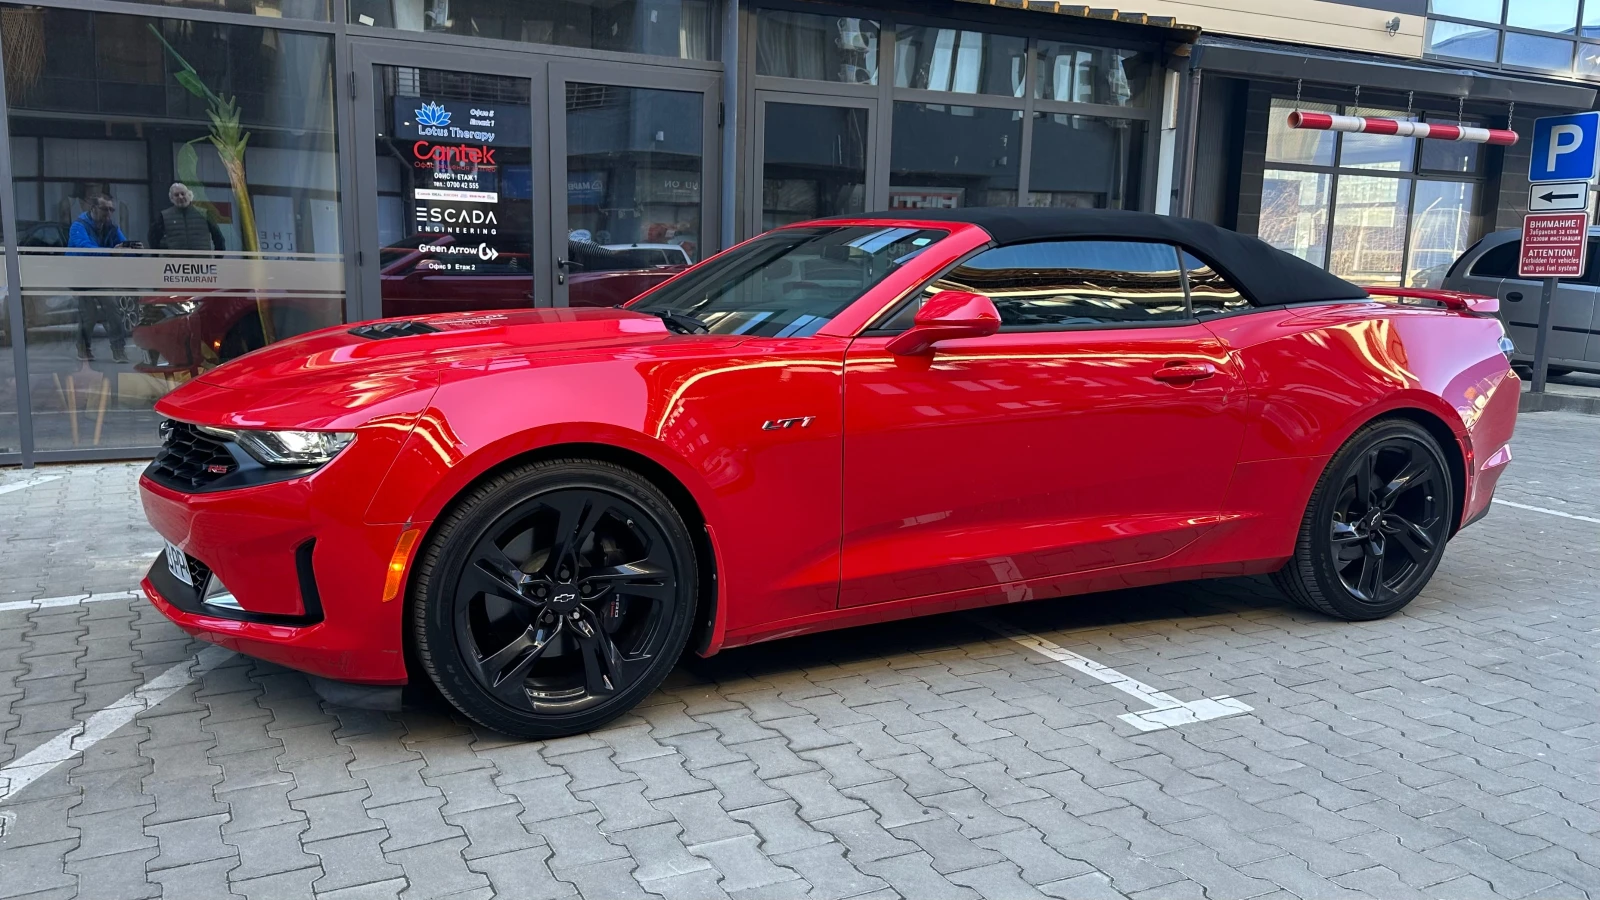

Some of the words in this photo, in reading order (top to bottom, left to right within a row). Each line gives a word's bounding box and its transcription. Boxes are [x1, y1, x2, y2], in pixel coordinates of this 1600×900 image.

[418, 125, 448, 137] Lotus
[450, 127, 495, 142] Therapy
[413, 140, 495, 164] Cantek
[1547, 124, 1583, 172] P
[416, 207, 498, 225] ESCADA
[1530, 219, 1580, 228] ВНИМАНИЕ!
[418, 225, 497, 235] ENGINEERING
[418, 244, 447, 253] Green
[448, 246, 478, 255] Arrow
[1528, 249, 1576, 257] ATTENTION!
[163, 263, 218, 275] AVENUE
[428, 263, 446, 271] Офис
[1558, 265, 1578, 273] system
[163, 275, 218, 283] RESTAURANT
